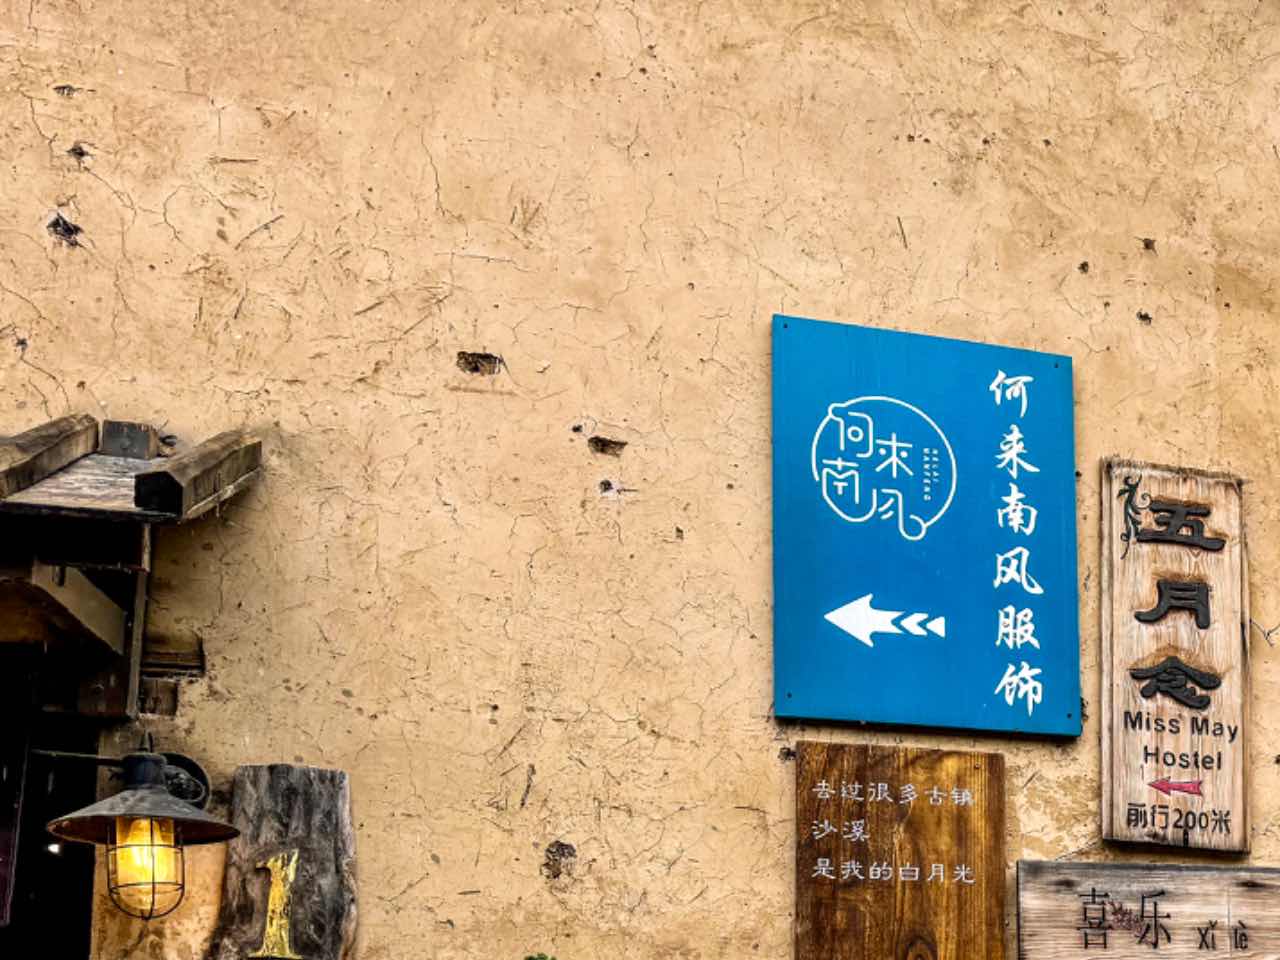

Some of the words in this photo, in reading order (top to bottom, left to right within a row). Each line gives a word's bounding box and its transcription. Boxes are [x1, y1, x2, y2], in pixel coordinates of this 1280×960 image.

[988, 369, 1044, 717] 何来南风服饰
[1123, 711, 1181, 735] Miss
[1191, 717, 1239, 742] May
[1144, 745, 1222, 771] Hostel
[811, 778, 976, 807] 去过很多古镇
[811, 818, 871, 842] 沙溪
[1127, 803, 1232, 834] 前行200米
[811, 857, 977, 885] 是我的白月光
[1076, 887, 1172, 950] 喜乐
